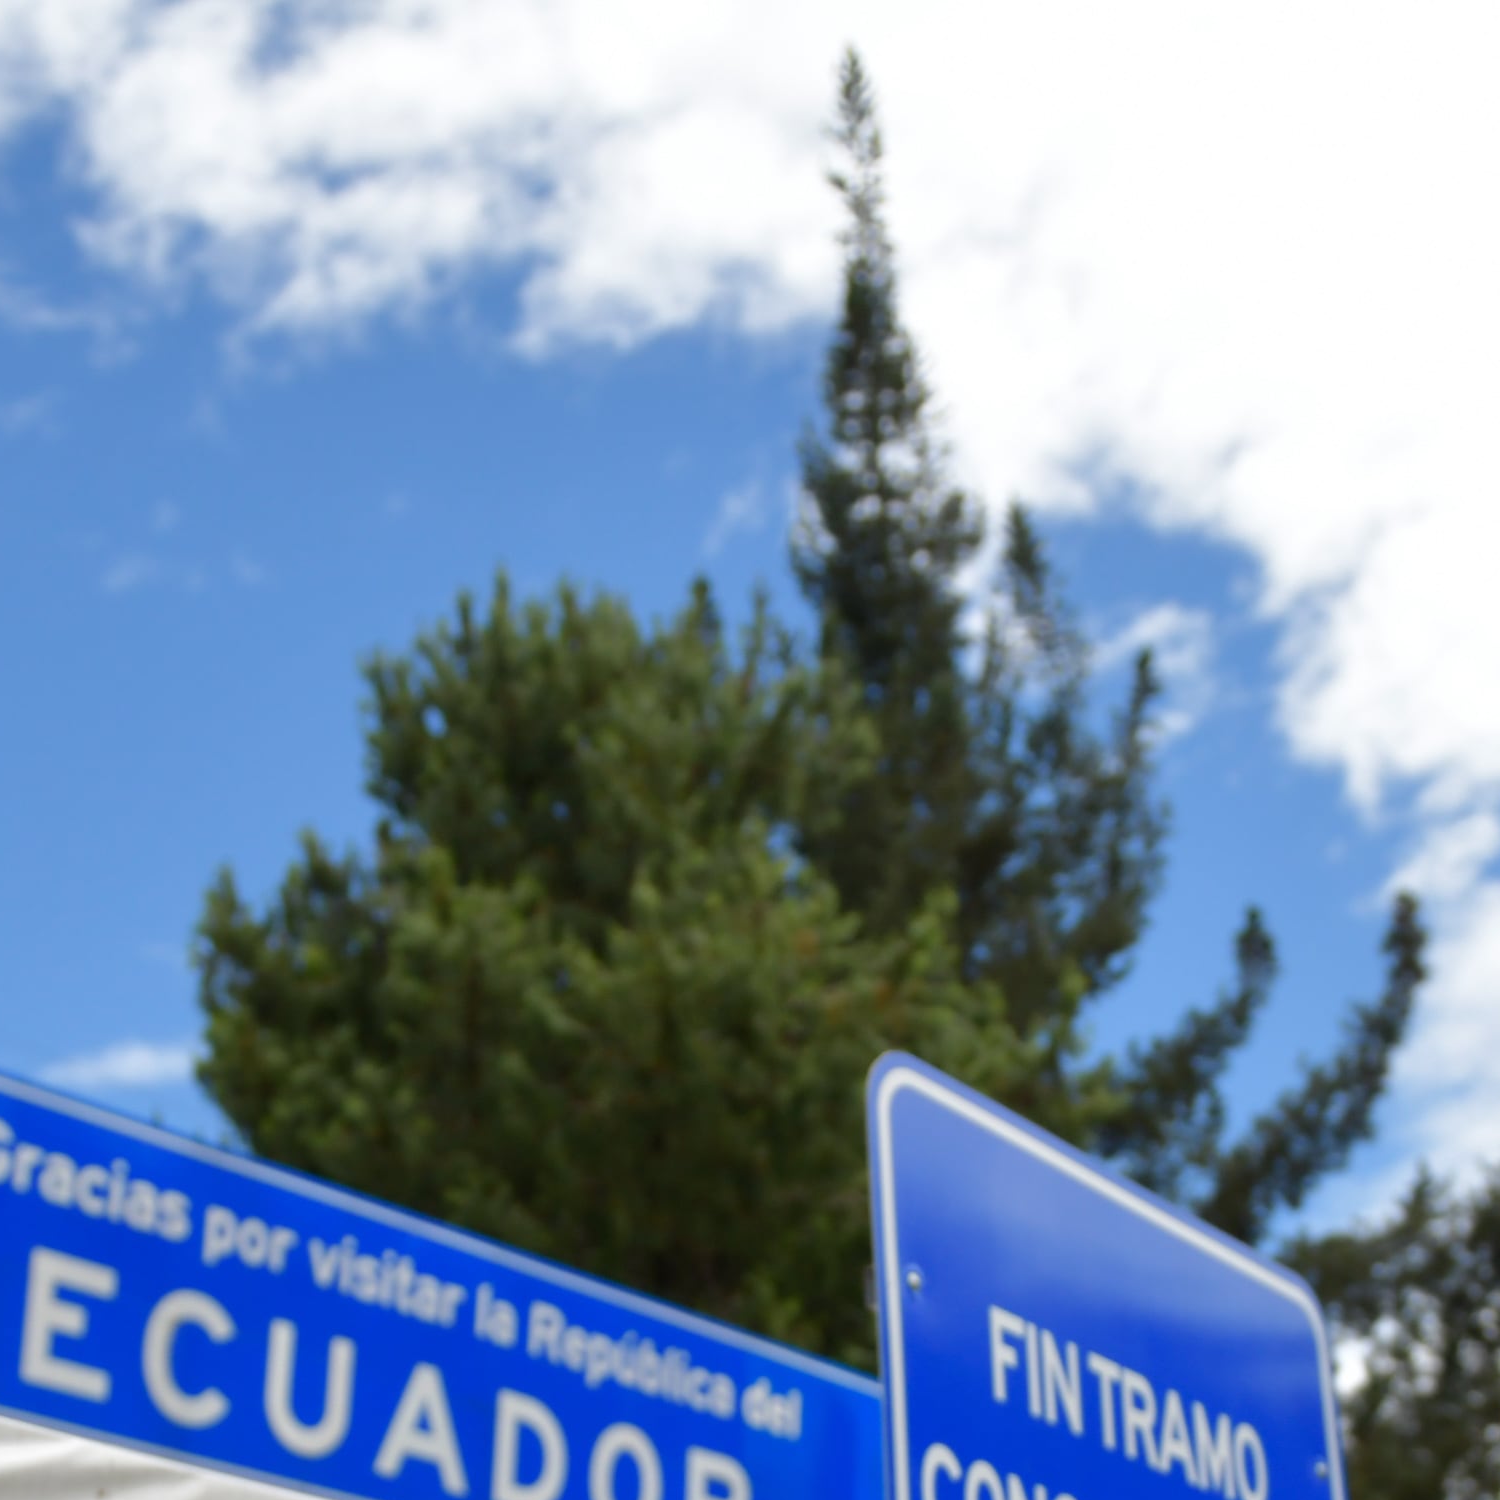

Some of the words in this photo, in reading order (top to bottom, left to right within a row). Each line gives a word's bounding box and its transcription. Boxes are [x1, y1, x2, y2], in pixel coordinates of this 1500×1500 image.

[202, 1205, 296, 1270] por
[308, 1231, 465, 1326] visitar
[474, 1283, 517, 1346] la
[527, 1301, 736, 1418] República
[741, 1379, 803, 1438] del
[988, 1303, 1084, 1436] FIN
